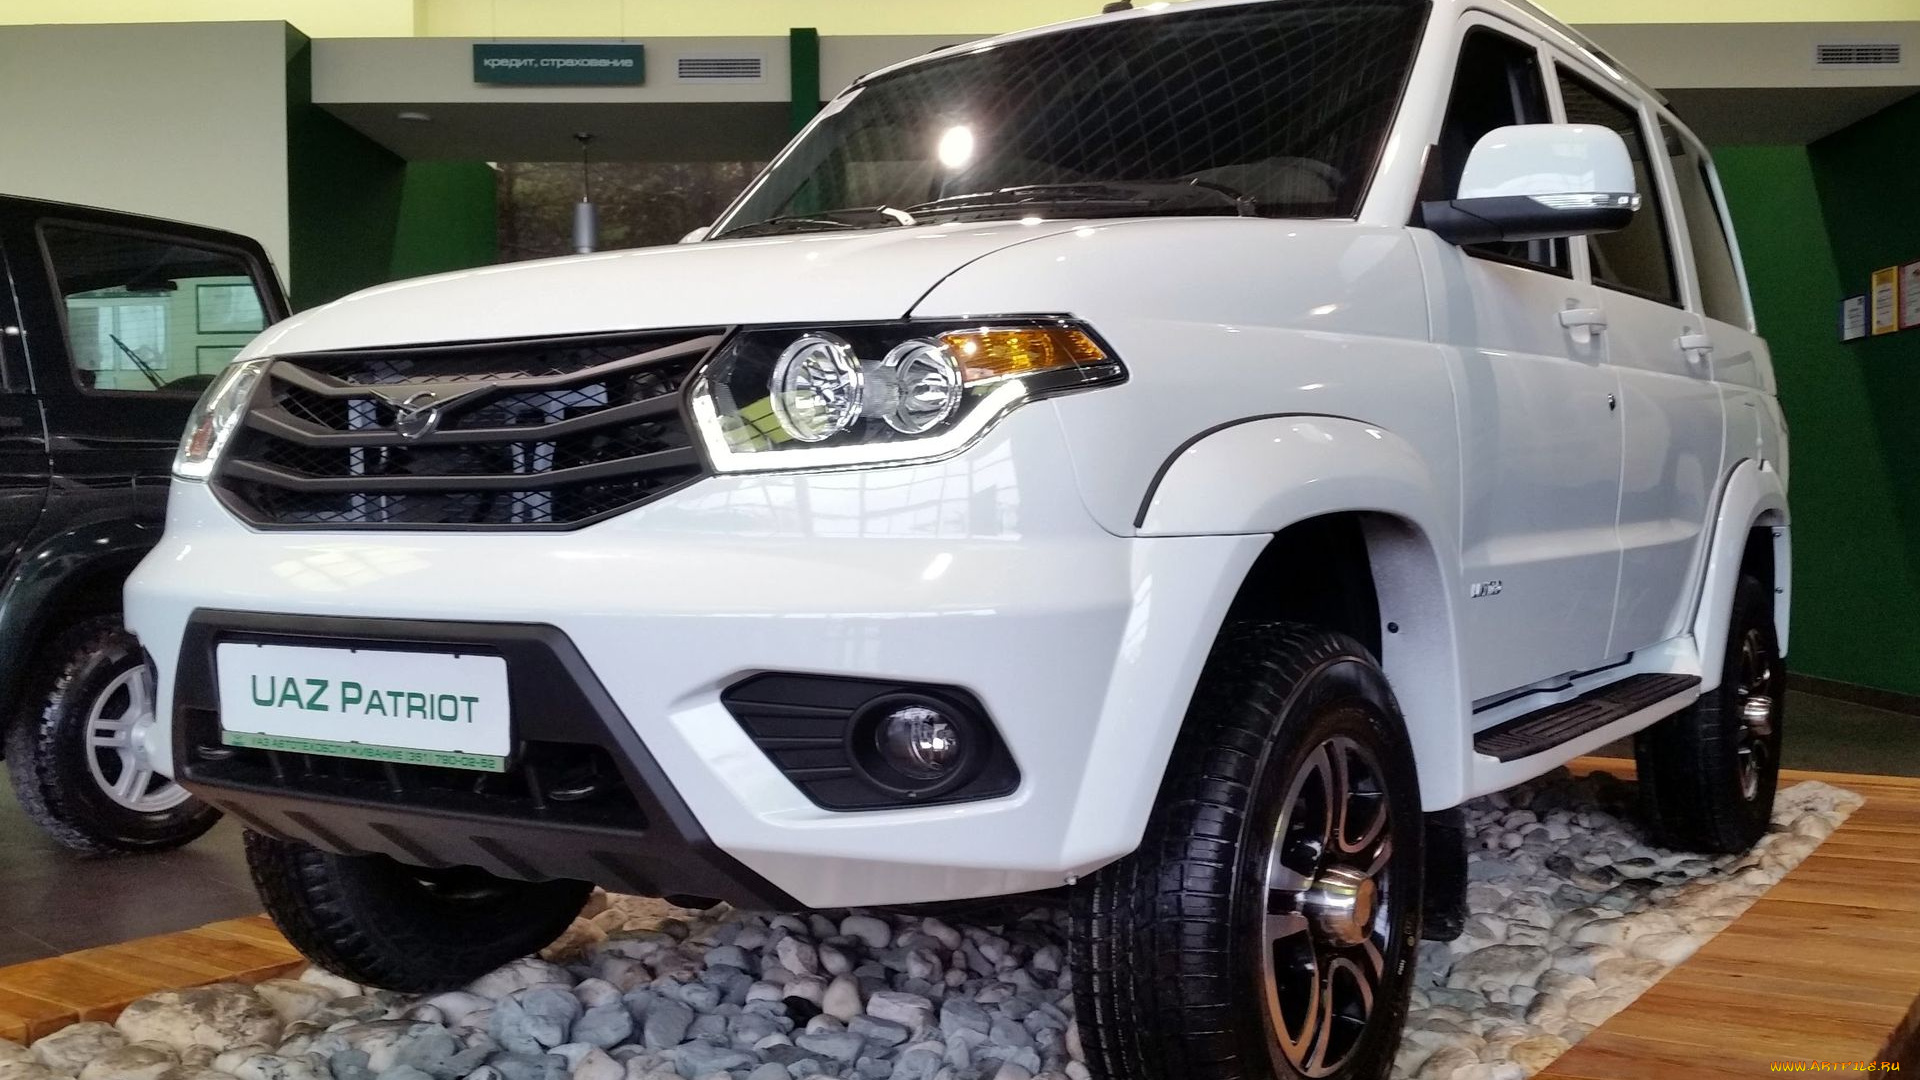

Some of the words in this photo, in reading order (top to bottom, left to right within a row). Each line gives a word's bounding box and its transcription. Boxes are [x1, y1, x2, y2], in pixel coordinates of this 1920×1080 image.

[483, 57, 538, 68] кредит,
[540, 58, 634, 69] страхование
[251, 674, 329, 712] UAZ
